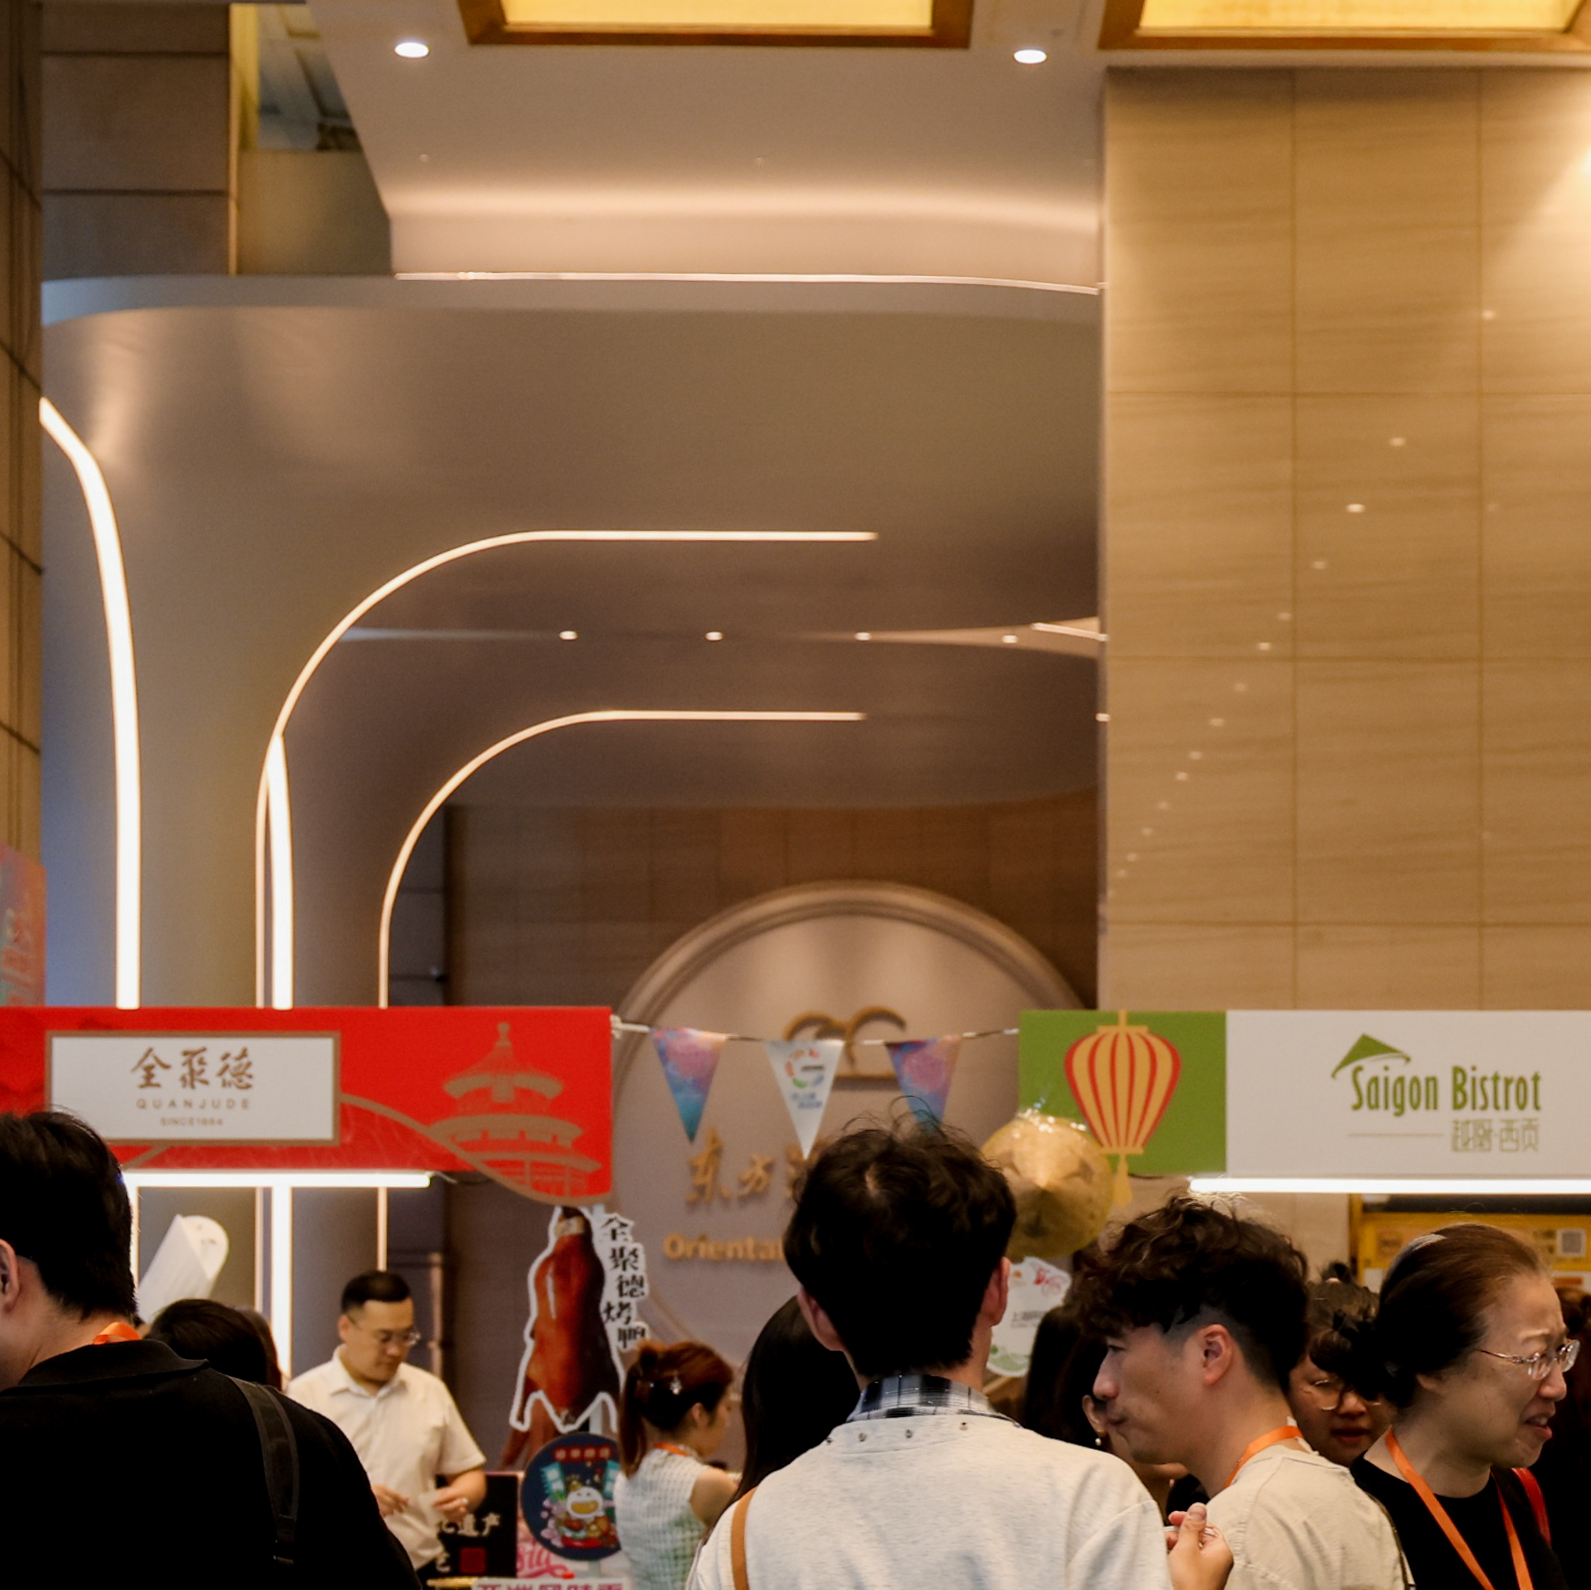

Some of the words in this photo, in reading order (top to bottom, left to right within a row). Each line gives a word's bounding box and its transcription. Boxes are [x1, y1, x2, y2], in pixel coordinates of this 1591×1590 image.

[136, 1099, 249, 1109] QUANJUDE
[1351, 1064, 1439, 1117] Saigon
[1451, 1064, 1542, 1111] Bistrot
